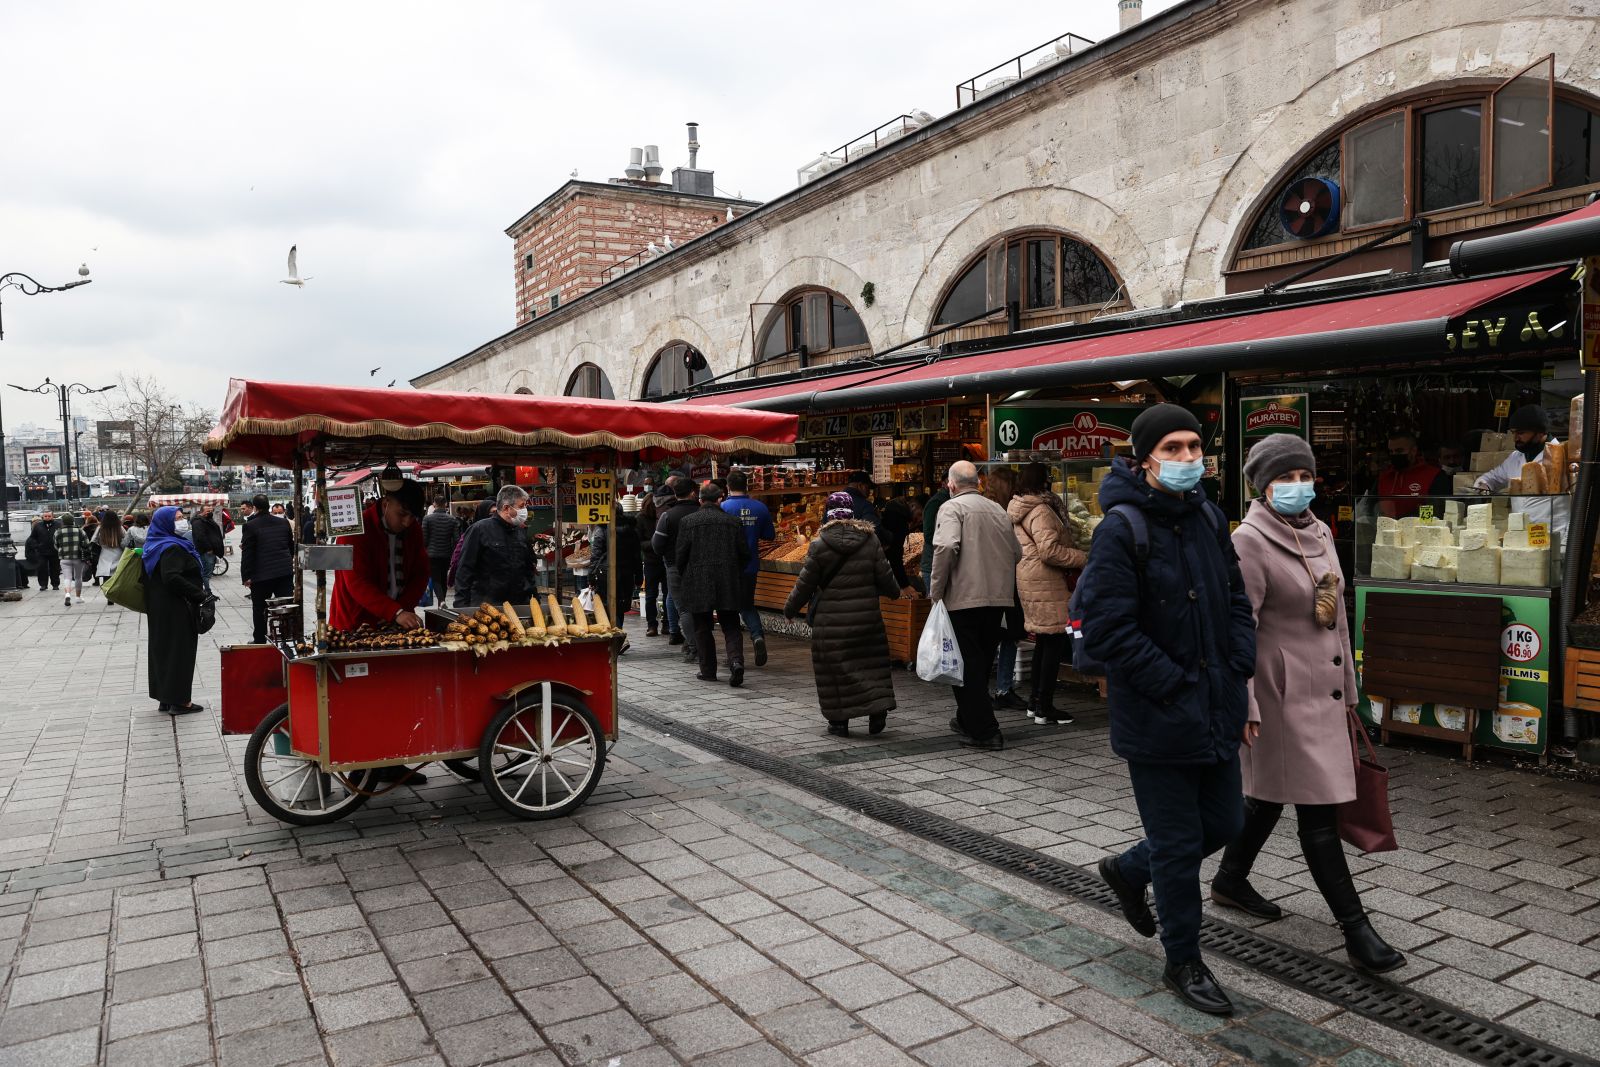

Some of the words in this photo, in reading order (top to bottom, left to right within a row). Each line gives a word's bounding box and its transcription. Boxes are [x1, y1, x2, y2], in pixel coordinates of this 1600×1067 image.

[1249, 412, 1297, 425] MURATBEY
[1001, 423, 1017, 442] 13
[581, 476, 611, 489] SÜT
[1507, 630, 1513, 641] 1
[1516, 630, 1532, 642] KG
[1506, 642, 1532, 658] 46.90
[1501, 667, 1541, 681] RİLMİŞ
